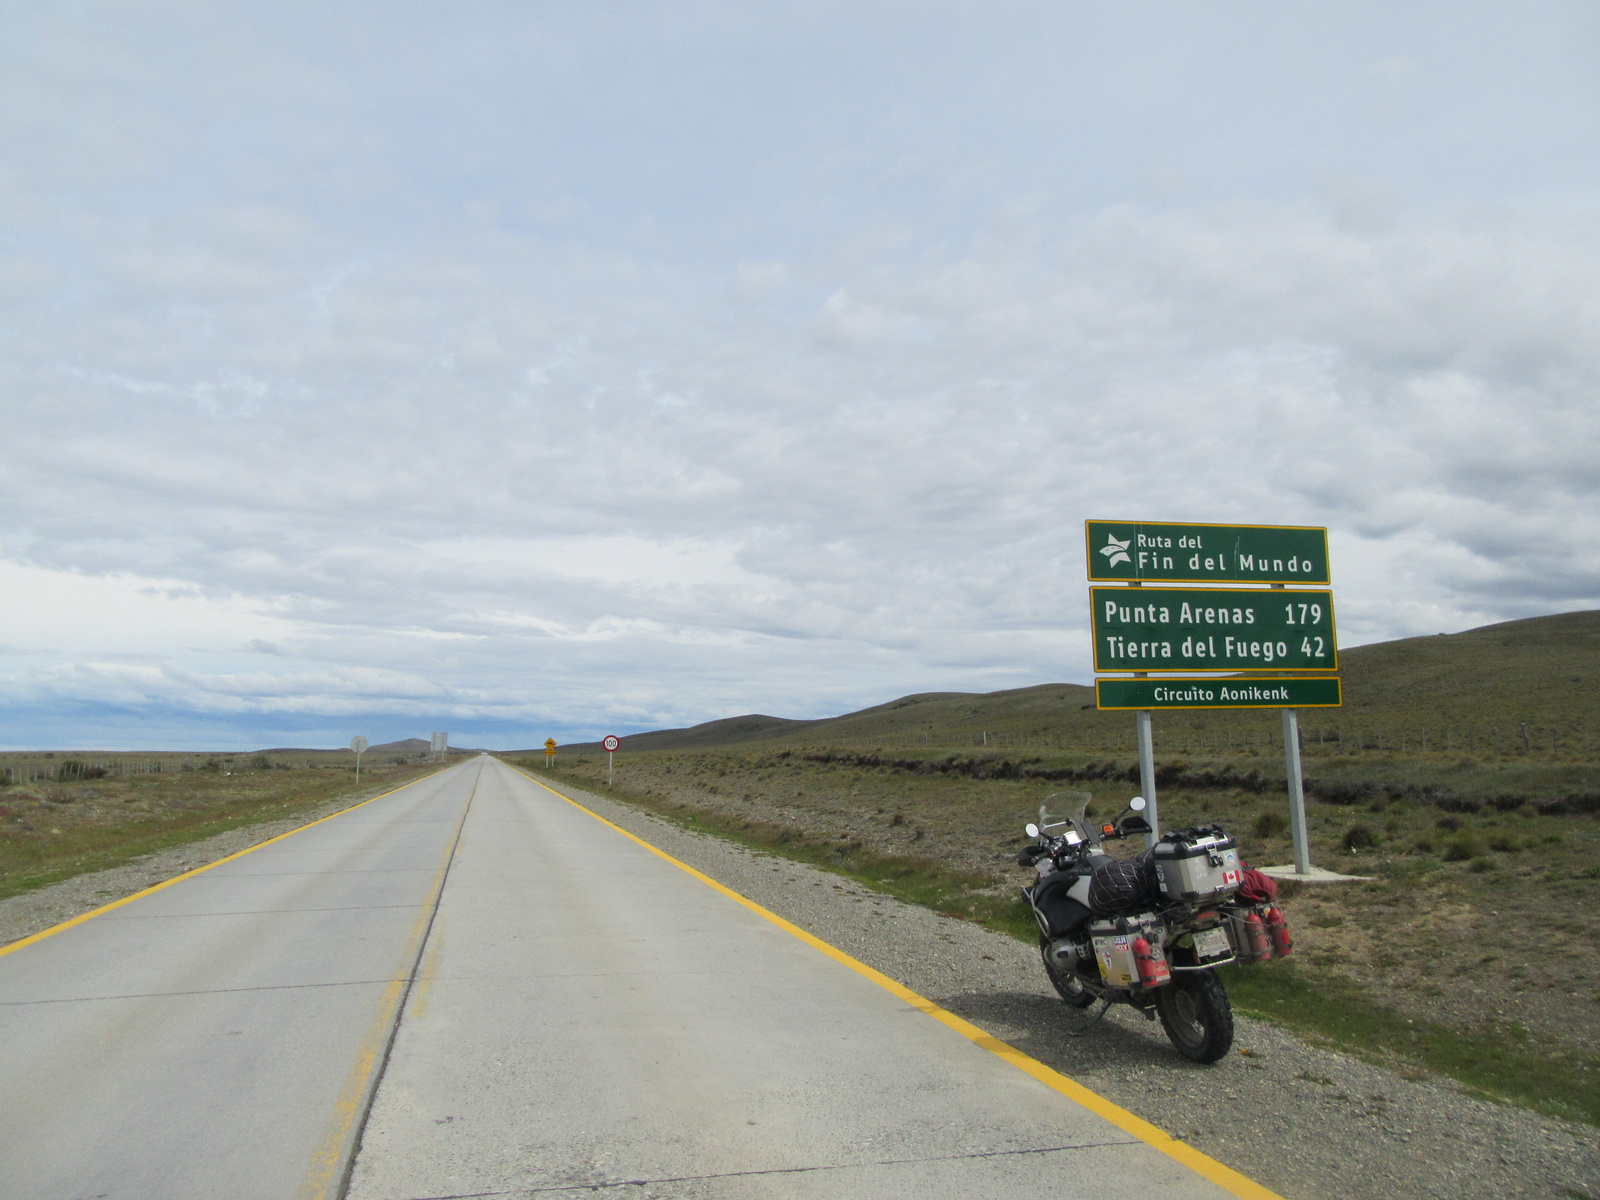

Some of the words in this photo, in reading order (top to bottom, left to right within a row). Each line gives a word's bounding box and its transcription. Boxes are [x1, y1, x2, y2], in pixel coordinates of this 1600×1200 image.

[1137, 533, 1172, 548] Ruta
[1178, 535, 1203, 549] del
[1138, 551, 1174, 570] Fin
[1188, 553, 1226, 571] del
[1239, 554, 1312, 573] Mundo
[1105, 600, 1170, 623] Punta
[1179, 602, 1255, 624] Arenas
[1285, 603, 1322, 625] 179
[1106, 635, 1171, 659] Tierra
[1181, 636, 1216, 658] del
[1225, 636, 1287, 662] Fuego
[1300, 636, 1325, 657] 42
[1154, 686, 1214, 701] Circuito
[1220, 686, 1289, 700] Aonikenk
